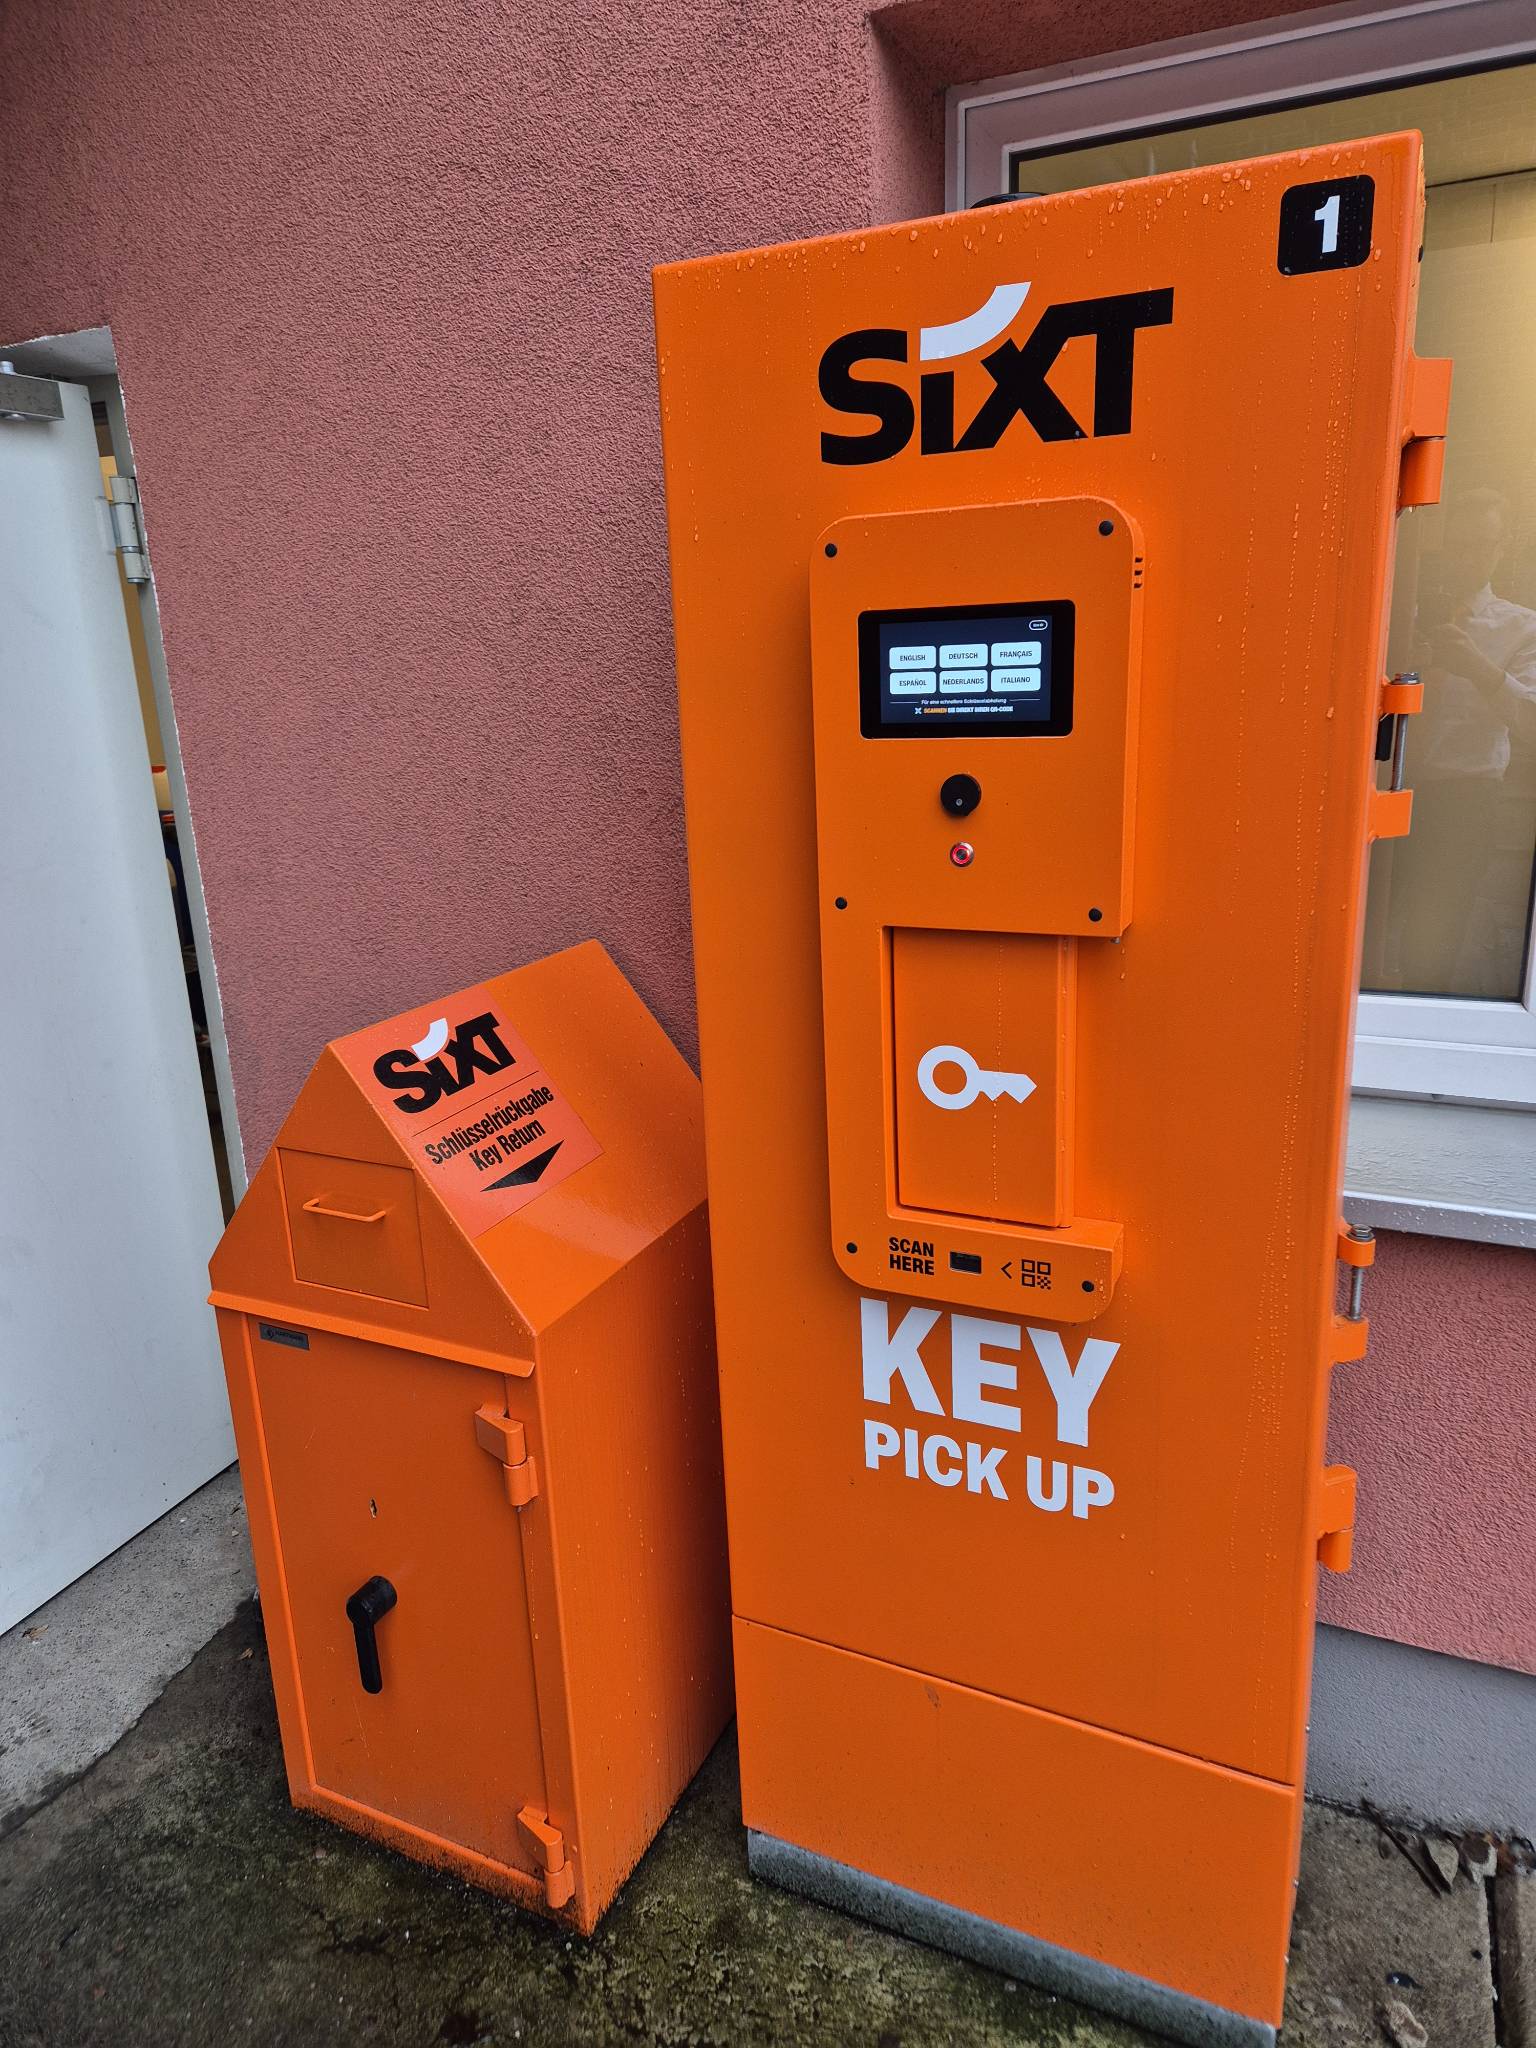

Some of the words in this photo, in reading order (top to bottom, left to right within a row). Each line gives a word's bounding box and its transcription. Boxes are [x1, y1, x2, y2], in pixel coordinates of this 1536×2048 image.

[1314, 195, 1341, 255] 1
[899, 654, 926, 662] ENGLISH
[948, 652, 978, 660] DEUTSCH
[999, 650, 1033, 659] FRANÇAIS
[899, 678, 927, 687] ESPAÑOL
[942, 677, 985, 686] NEDERLANDS
[1000, 676, 1031, 685] ITALIANO
[424, 1086, 554, 1165] Schlüsselrückgabe
[469, 1144, 503, 1172] Key
[499, 1119, 546, 1158] Return
[888, 1236, 935, 1258] SCAN
[888, 1253, 935, 1276] HERE
[860, 1297, 1121, 1448] KEY
[864, 1419, 1009, 1501] PICK
[1026, 1455, 1115, 1520] UP
